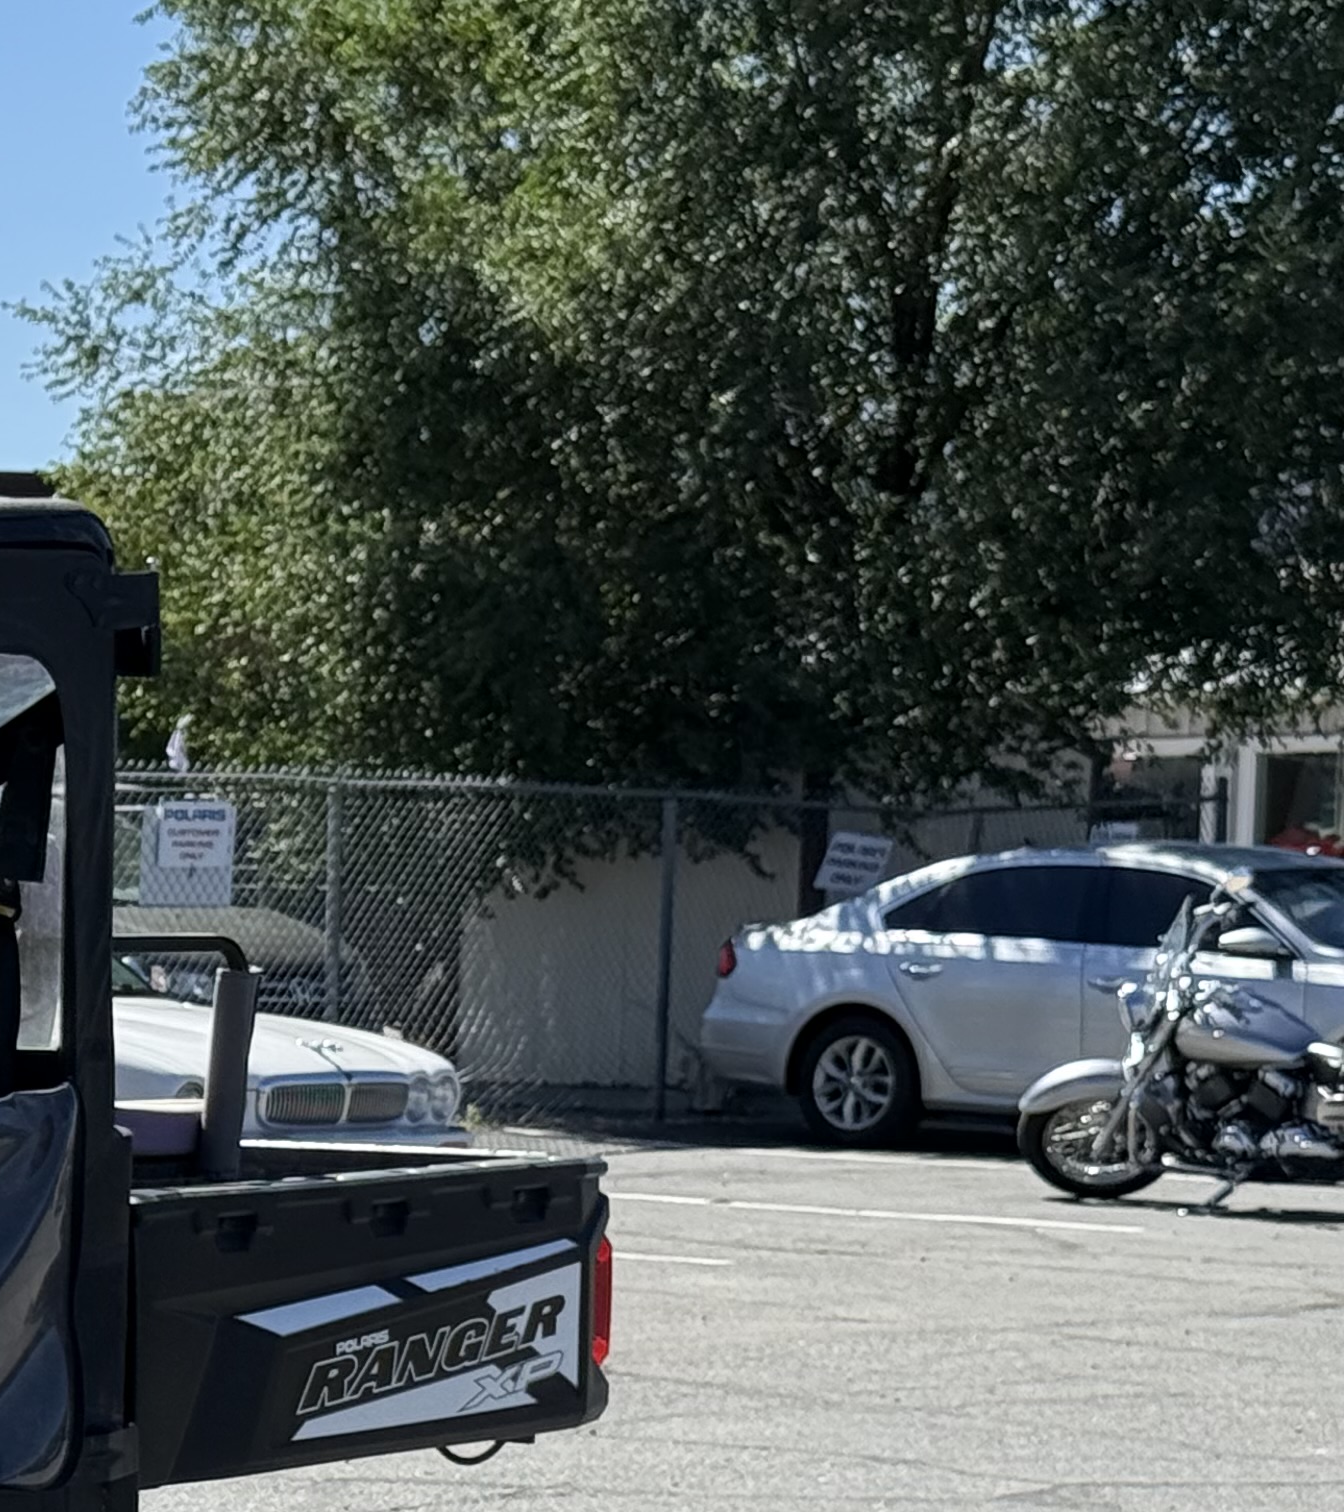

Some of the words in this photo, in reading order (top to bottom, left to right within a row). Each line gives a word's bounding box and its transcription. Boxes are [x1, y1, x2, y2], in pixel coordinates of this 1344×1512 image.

[164, 808, 226, 823] POLARIS
[295, 1294, 566, 1415] RANGER
[335, 1329, 389, 1356] POLARIS
[455, 1350, 564, 1413] XP
